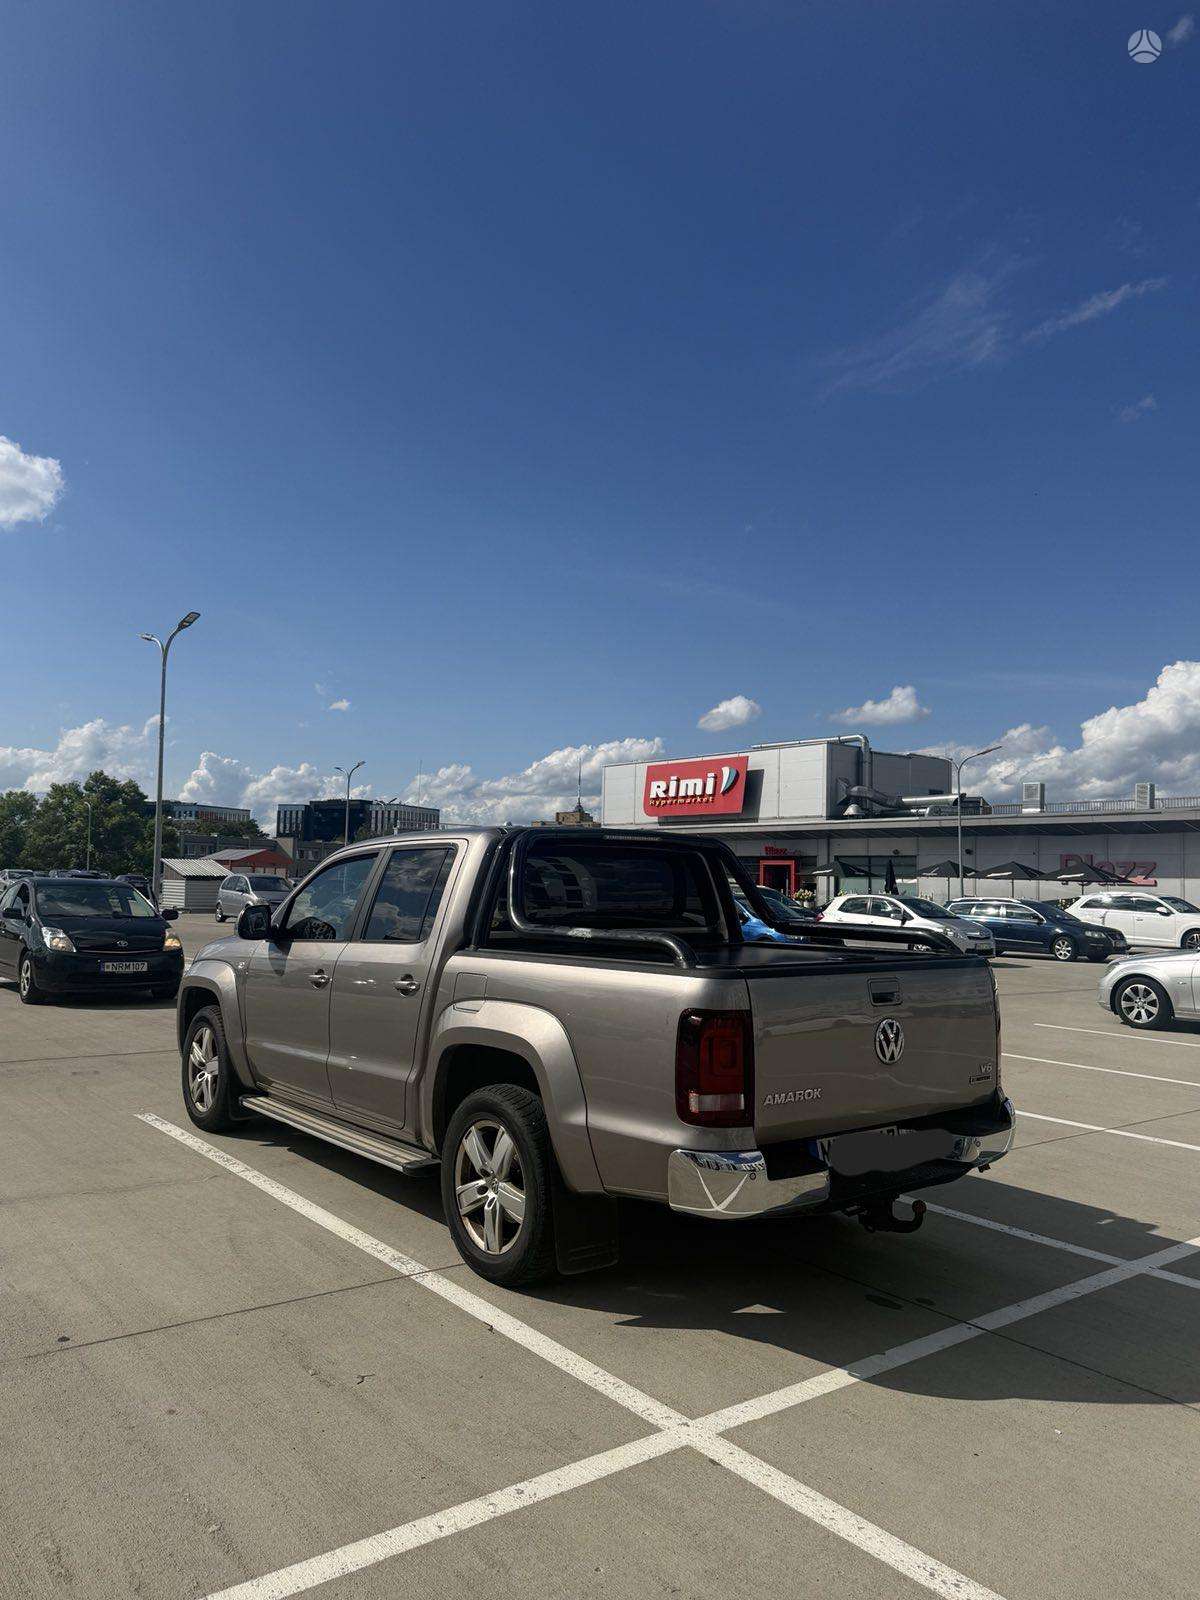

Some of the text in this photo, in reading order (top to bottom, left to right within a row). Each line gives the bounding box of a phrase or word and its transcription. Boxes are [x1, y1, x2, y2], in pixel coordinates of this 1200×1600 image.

[649, 772, 716, 798] Rimi
[649, 796, 715, 807] Hypermarket
[763, 1088, 822, 1106] AMAROK
